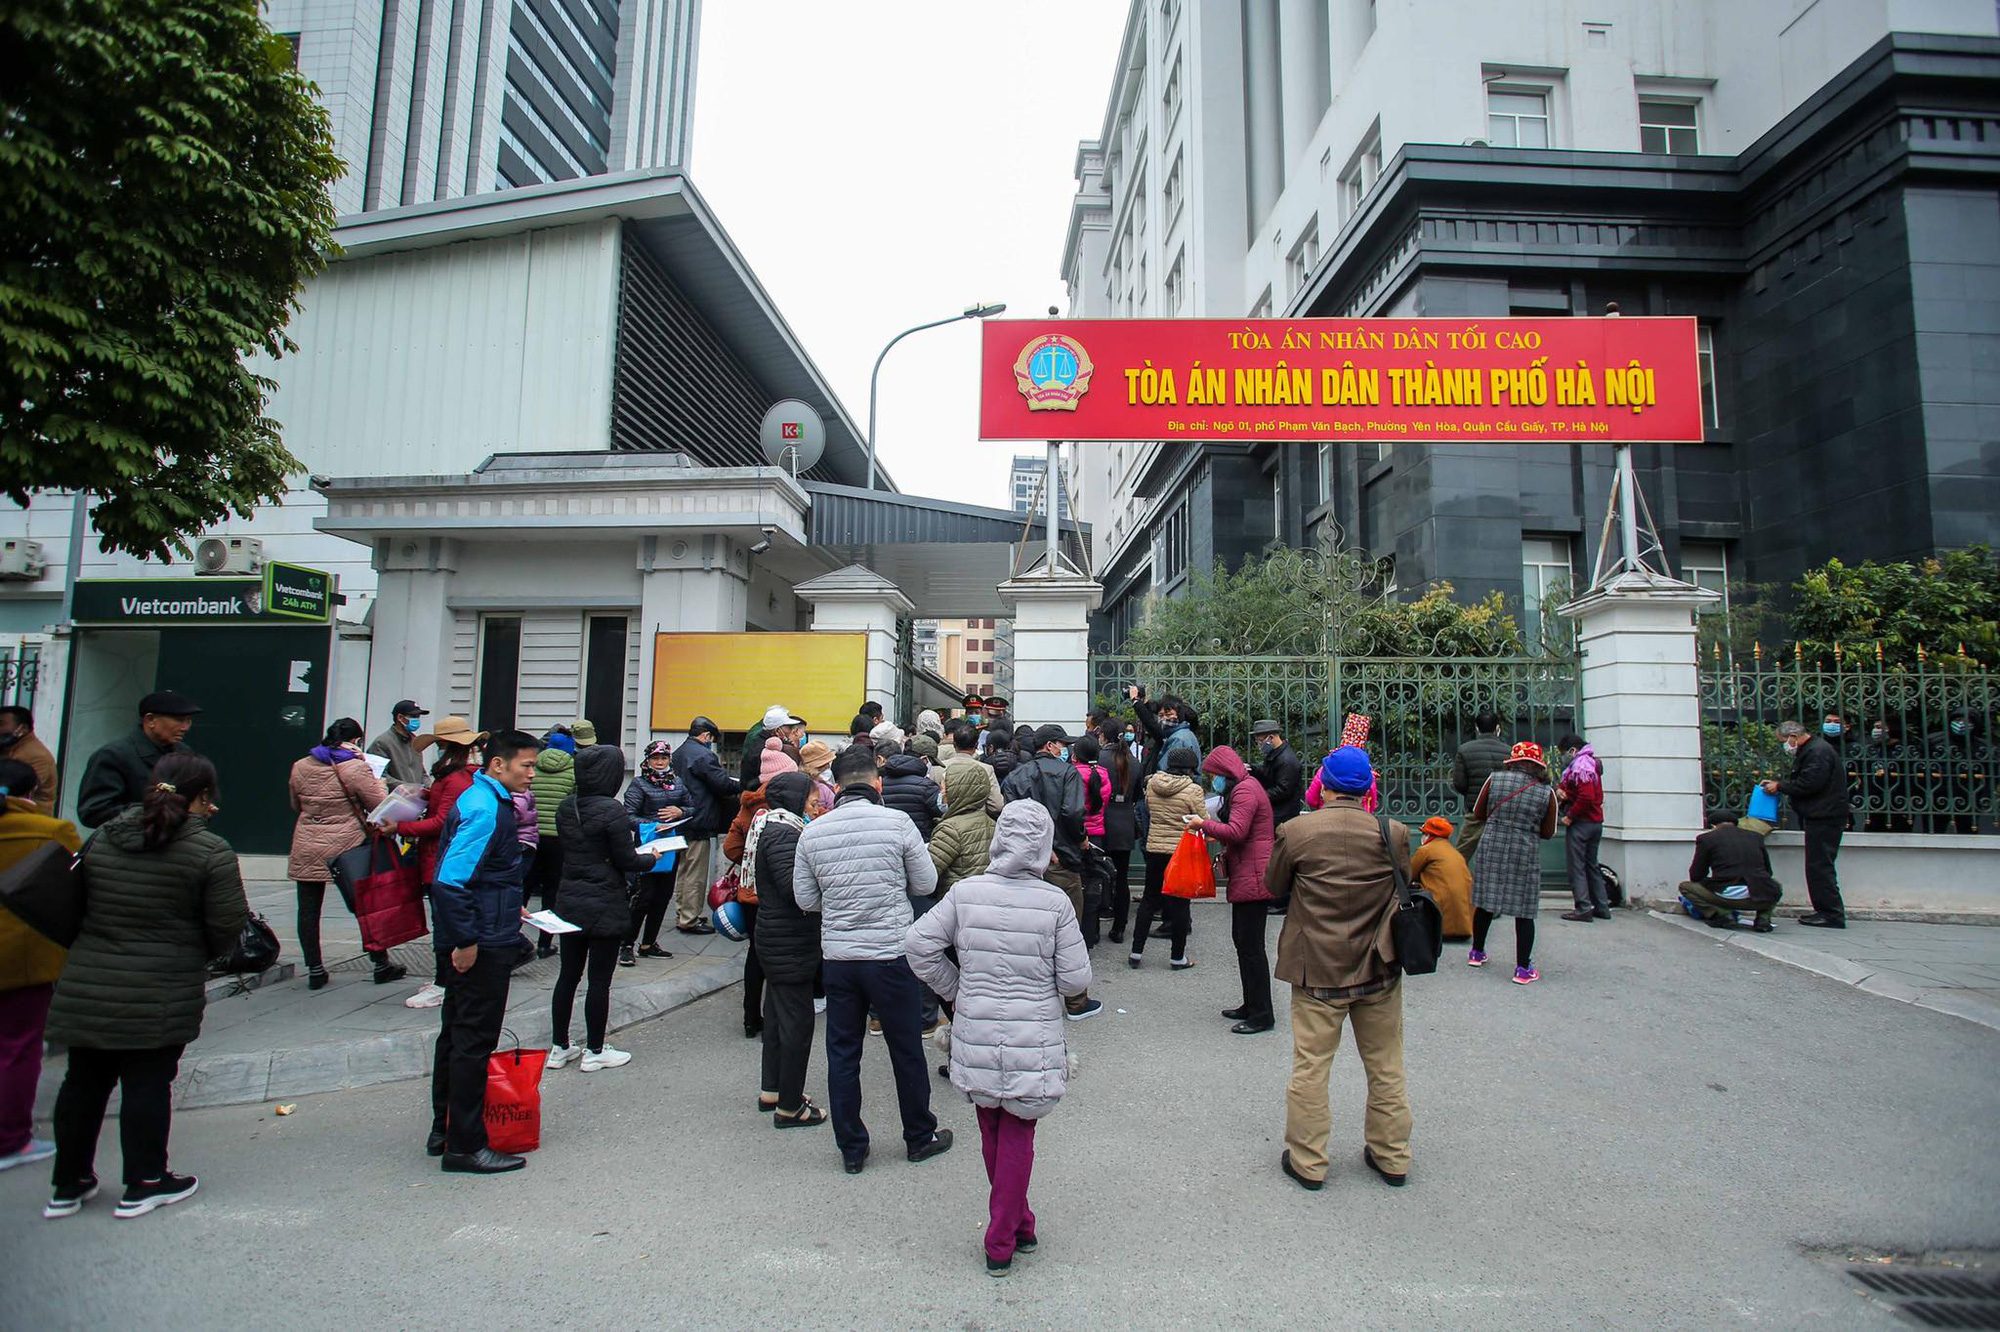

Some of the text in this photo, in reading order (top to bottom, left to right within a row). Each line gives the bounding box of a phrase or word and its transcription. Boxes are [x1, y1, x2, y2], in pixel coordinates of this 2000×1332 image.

[1228, 324, 1541, 349] TÒA ÁN NHÂN DÂN TỐI CAO
[1125, 356, 1656, 413] TÒA ÁN NHÂN DÂN THÀNH PHỐ HÀ NỘI
[1168, 421, 1185, 432] Địa
[1213, 421, 1235, 433] Ngõ
[1255, 420, 1276, 432] phố
[1279, 421, 1308, 433] Phạm
[1311, 421, 1330, 431] Văn
[1367, 420, 1407, 433] Phường
[1412, 421, 1431, 431] Yên
[1463, 421, 1492, 433] Quận
[1551, 422, 1569, 432] TP.
[1572, 422, 1587, 432] Hà
[1590, 421, 1609, 434] Nội
[275, 582, 324, 600] Vietcombank
[121, 597, 242, 614] Vietcombank
